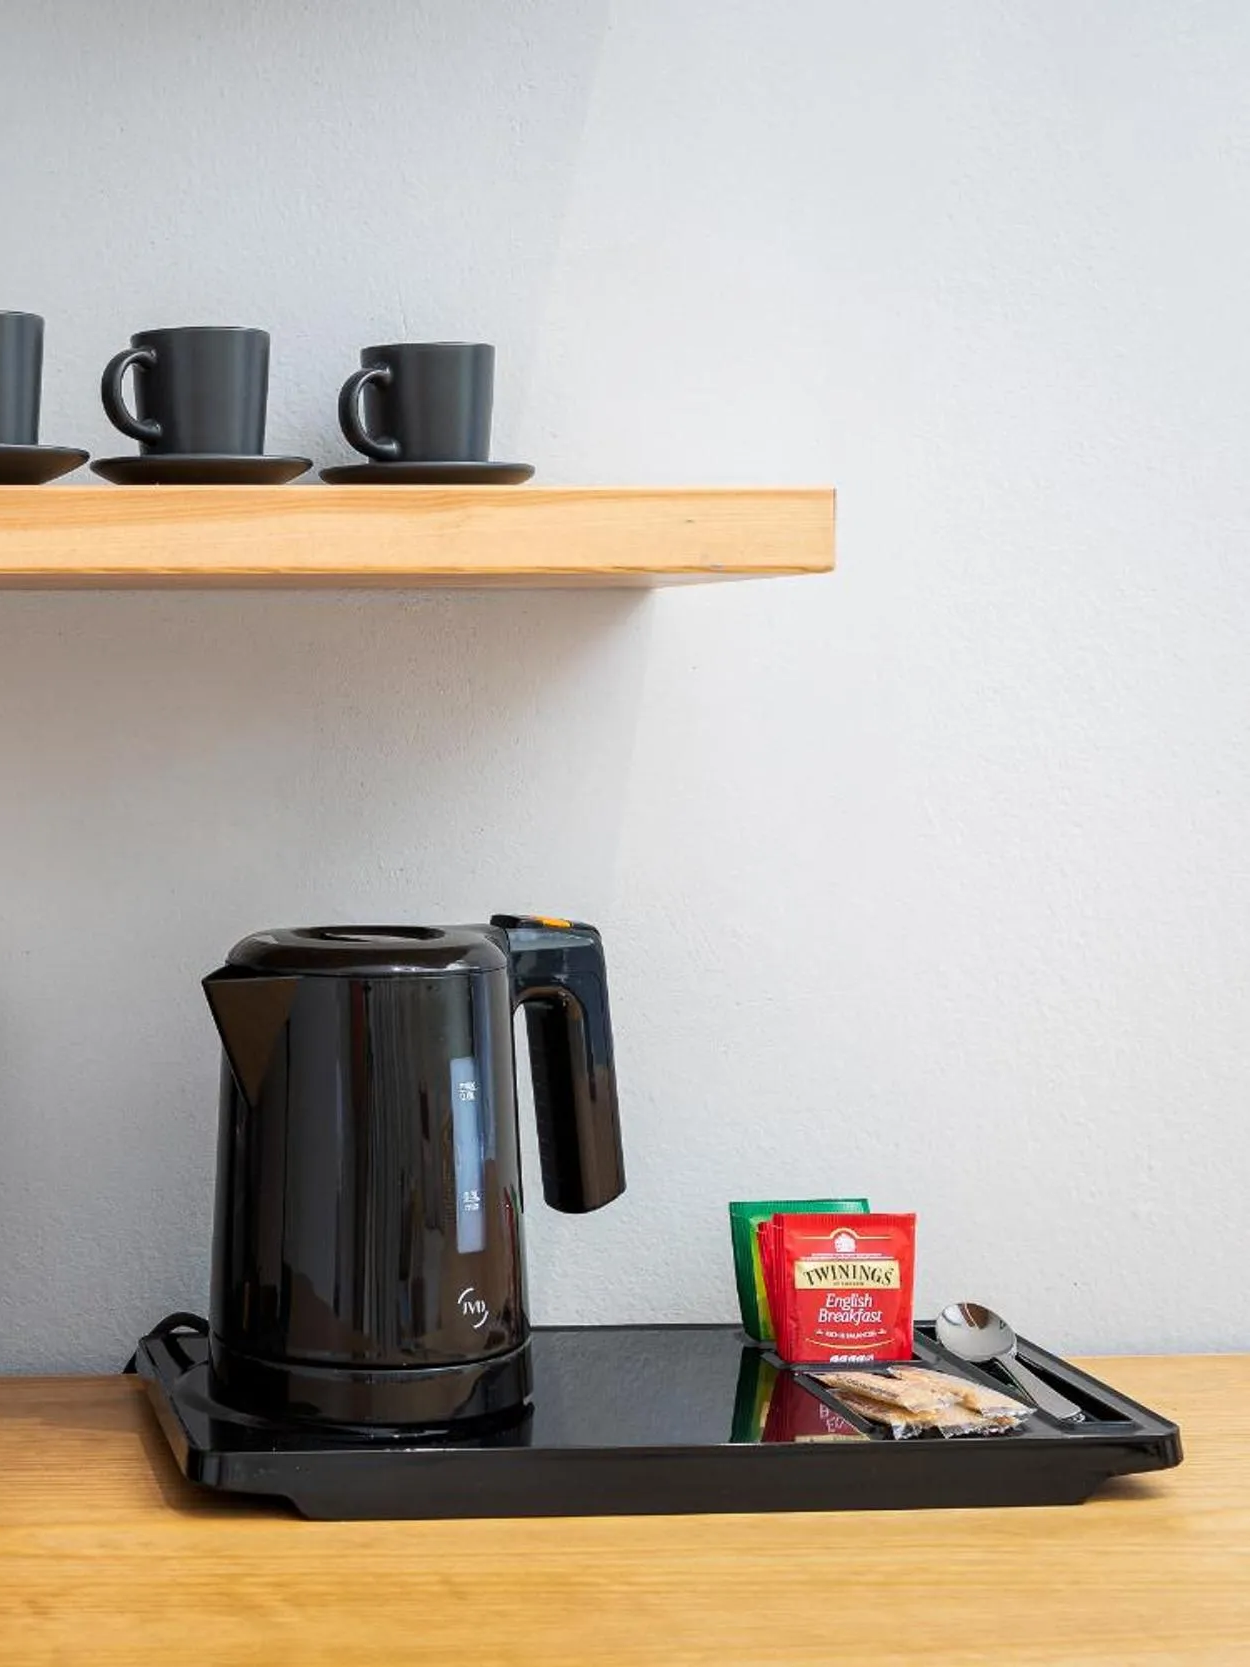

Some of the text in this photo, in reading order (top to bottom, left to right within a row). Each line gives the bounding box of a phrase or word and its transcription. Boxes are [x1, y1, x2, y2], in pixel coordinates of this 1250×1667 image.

[803, 1264, 894, 1286] TWININGS
[826, 1293, 873, 1311] English
[818, 1307, 883, 1326] Breakfast
